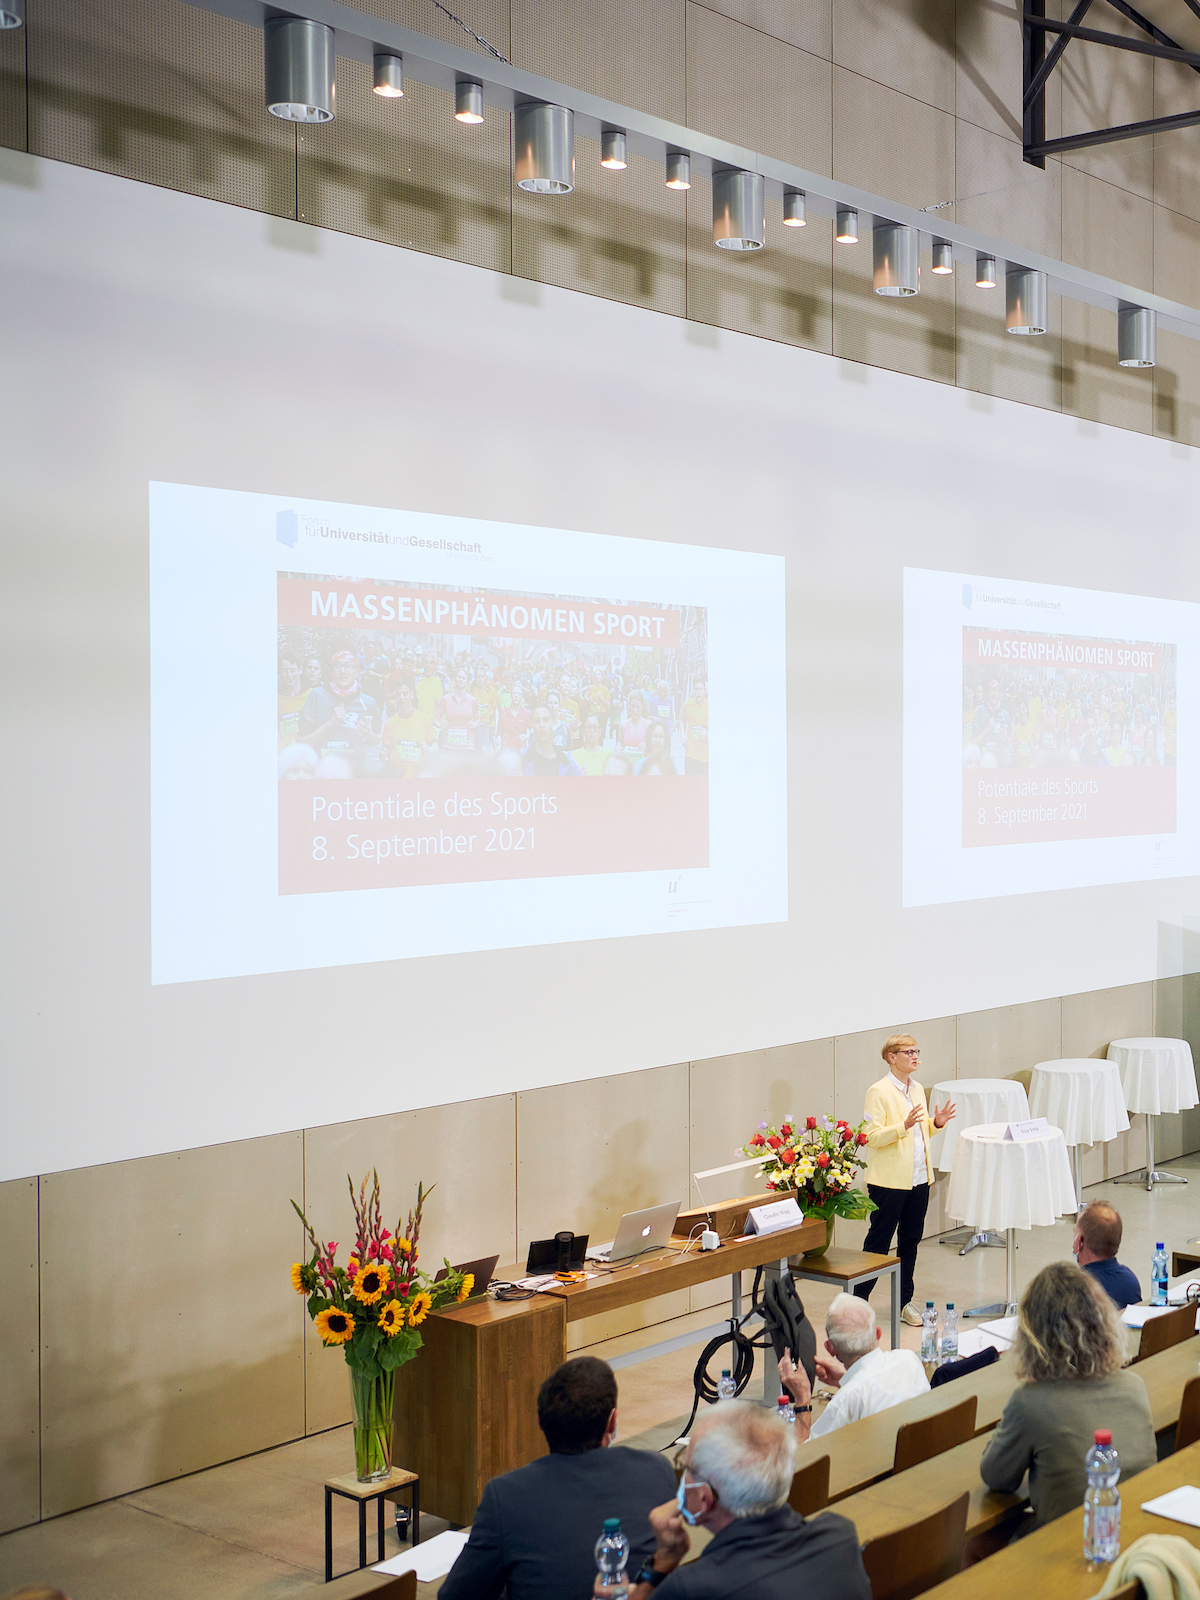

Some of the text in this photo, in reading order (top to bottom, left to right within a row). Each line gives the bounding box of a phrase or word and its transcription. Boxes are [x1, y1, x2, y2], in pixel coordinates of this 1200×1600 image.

[301, 514, 331, 526] Forum
[311, 590, 667, 639] MASSENPHÄNOMEN SPORT
[978, 638, 1155, 668] MASSENPHÄNOMEN SPORT
[978, 777, 1099, 799] Potentiale des Sports
[312, 791, 559, 822] Potentiale des Sports
[977, 802, 1088, 828] 8. September 2021
[312, 826, 536, 865] 8. September 2021
